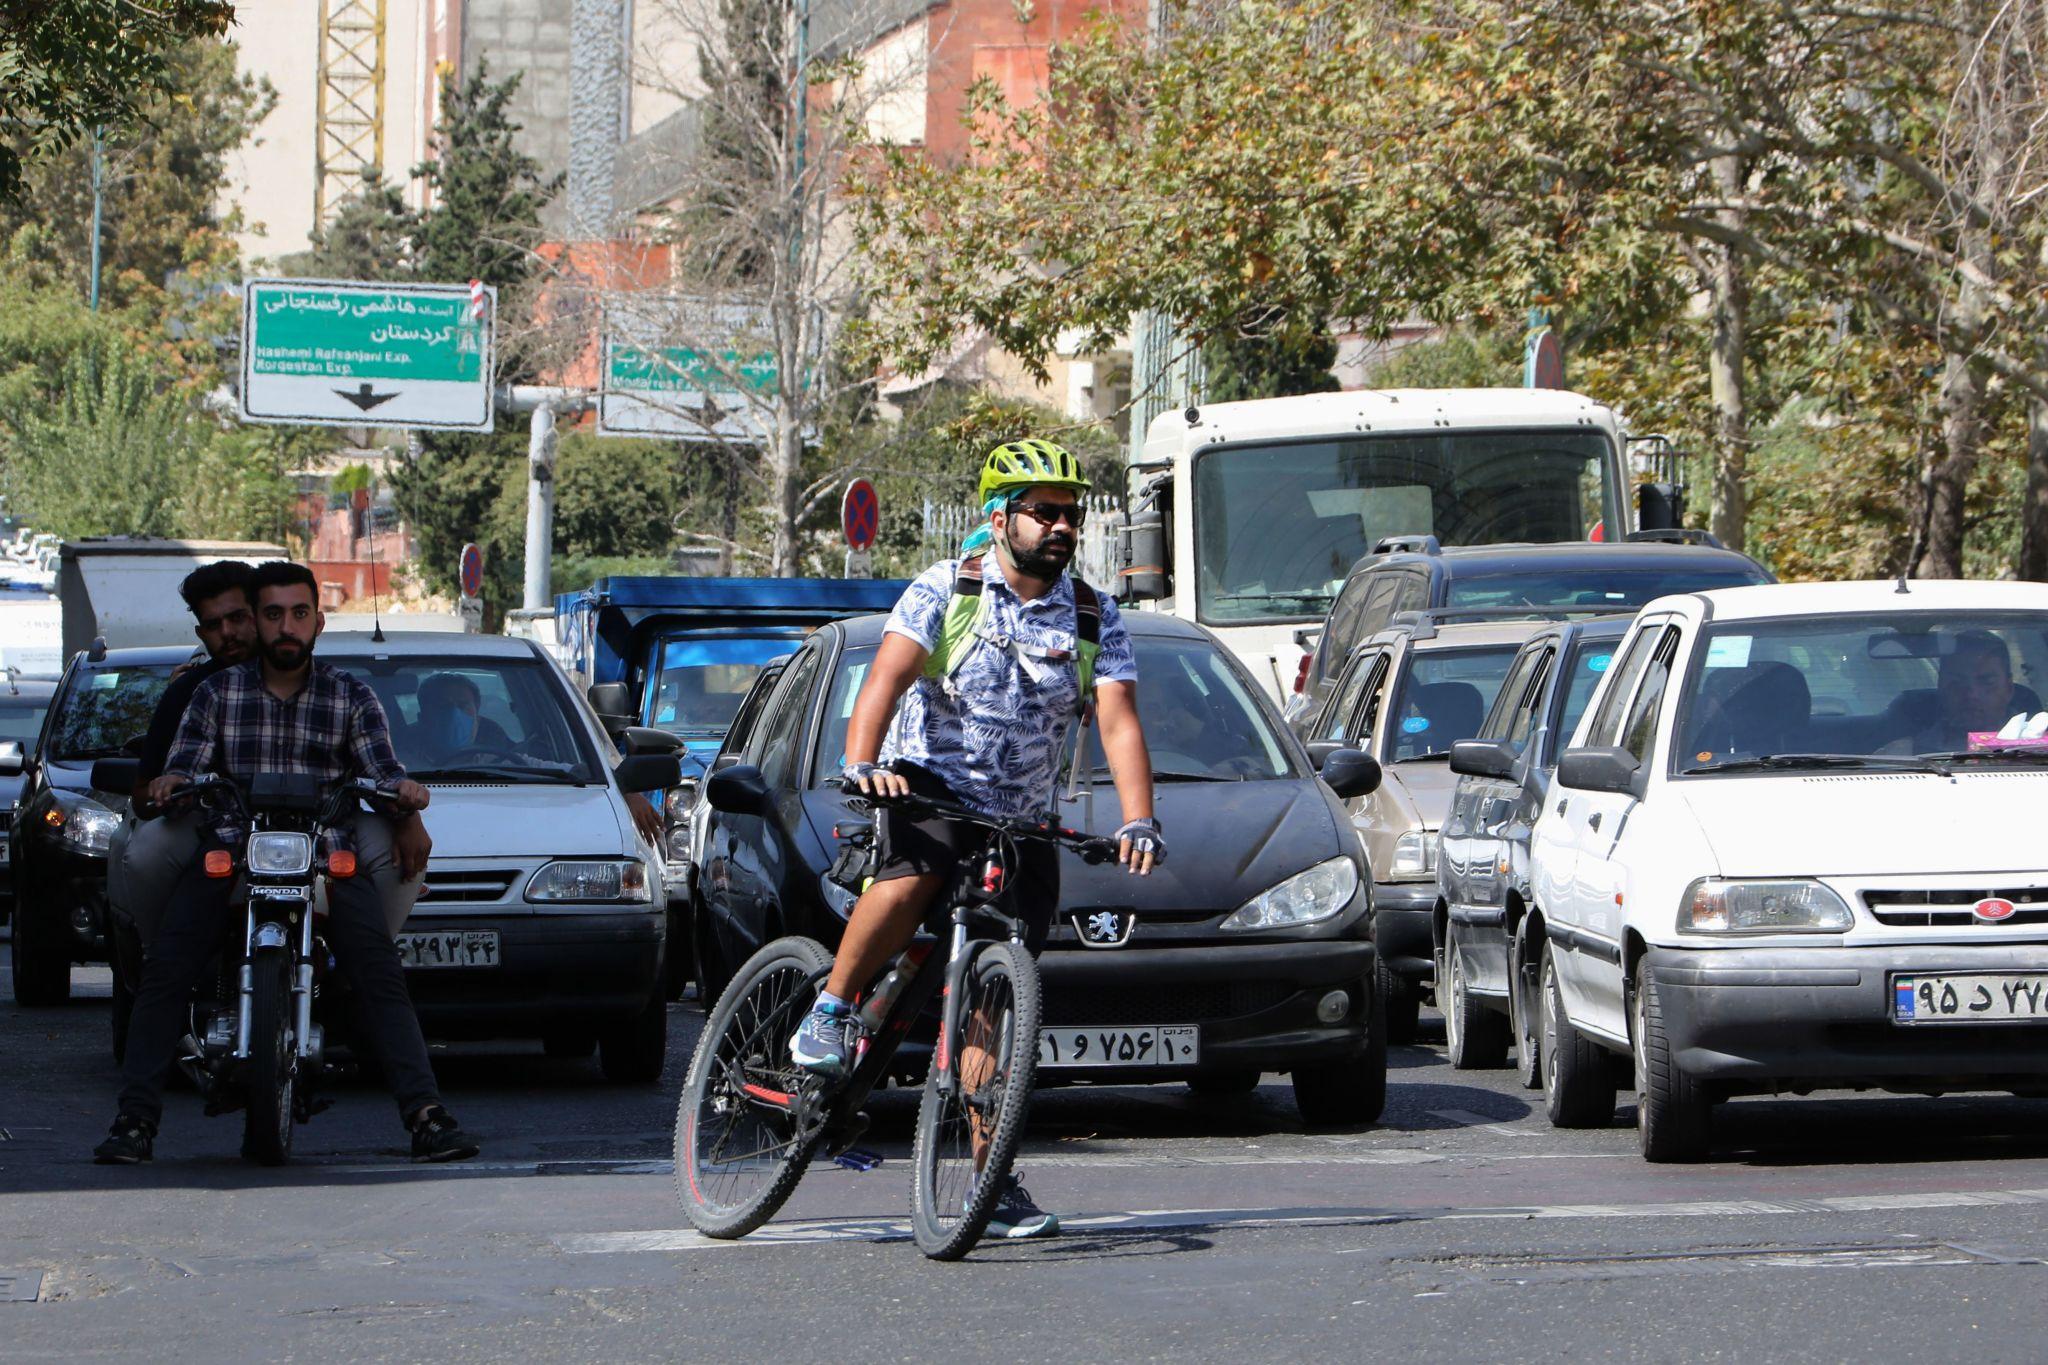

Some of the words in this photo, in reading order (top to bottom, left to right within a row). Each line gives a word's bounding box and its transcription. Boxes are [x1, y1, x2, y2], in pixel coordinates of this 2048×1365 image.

[263, 293, 349, 316] رفسنجانی
[351, 296, 417, 317] هاشمی
[370, 323, 455, 346] کردستان
[256, 345, 312, 358] Hashemi
[315, 347, 382, 363] Rafsanjani
[1163, 1028, 1194, 1036] ایران
[1163, 1037, 1194, 1062] ۱۰
